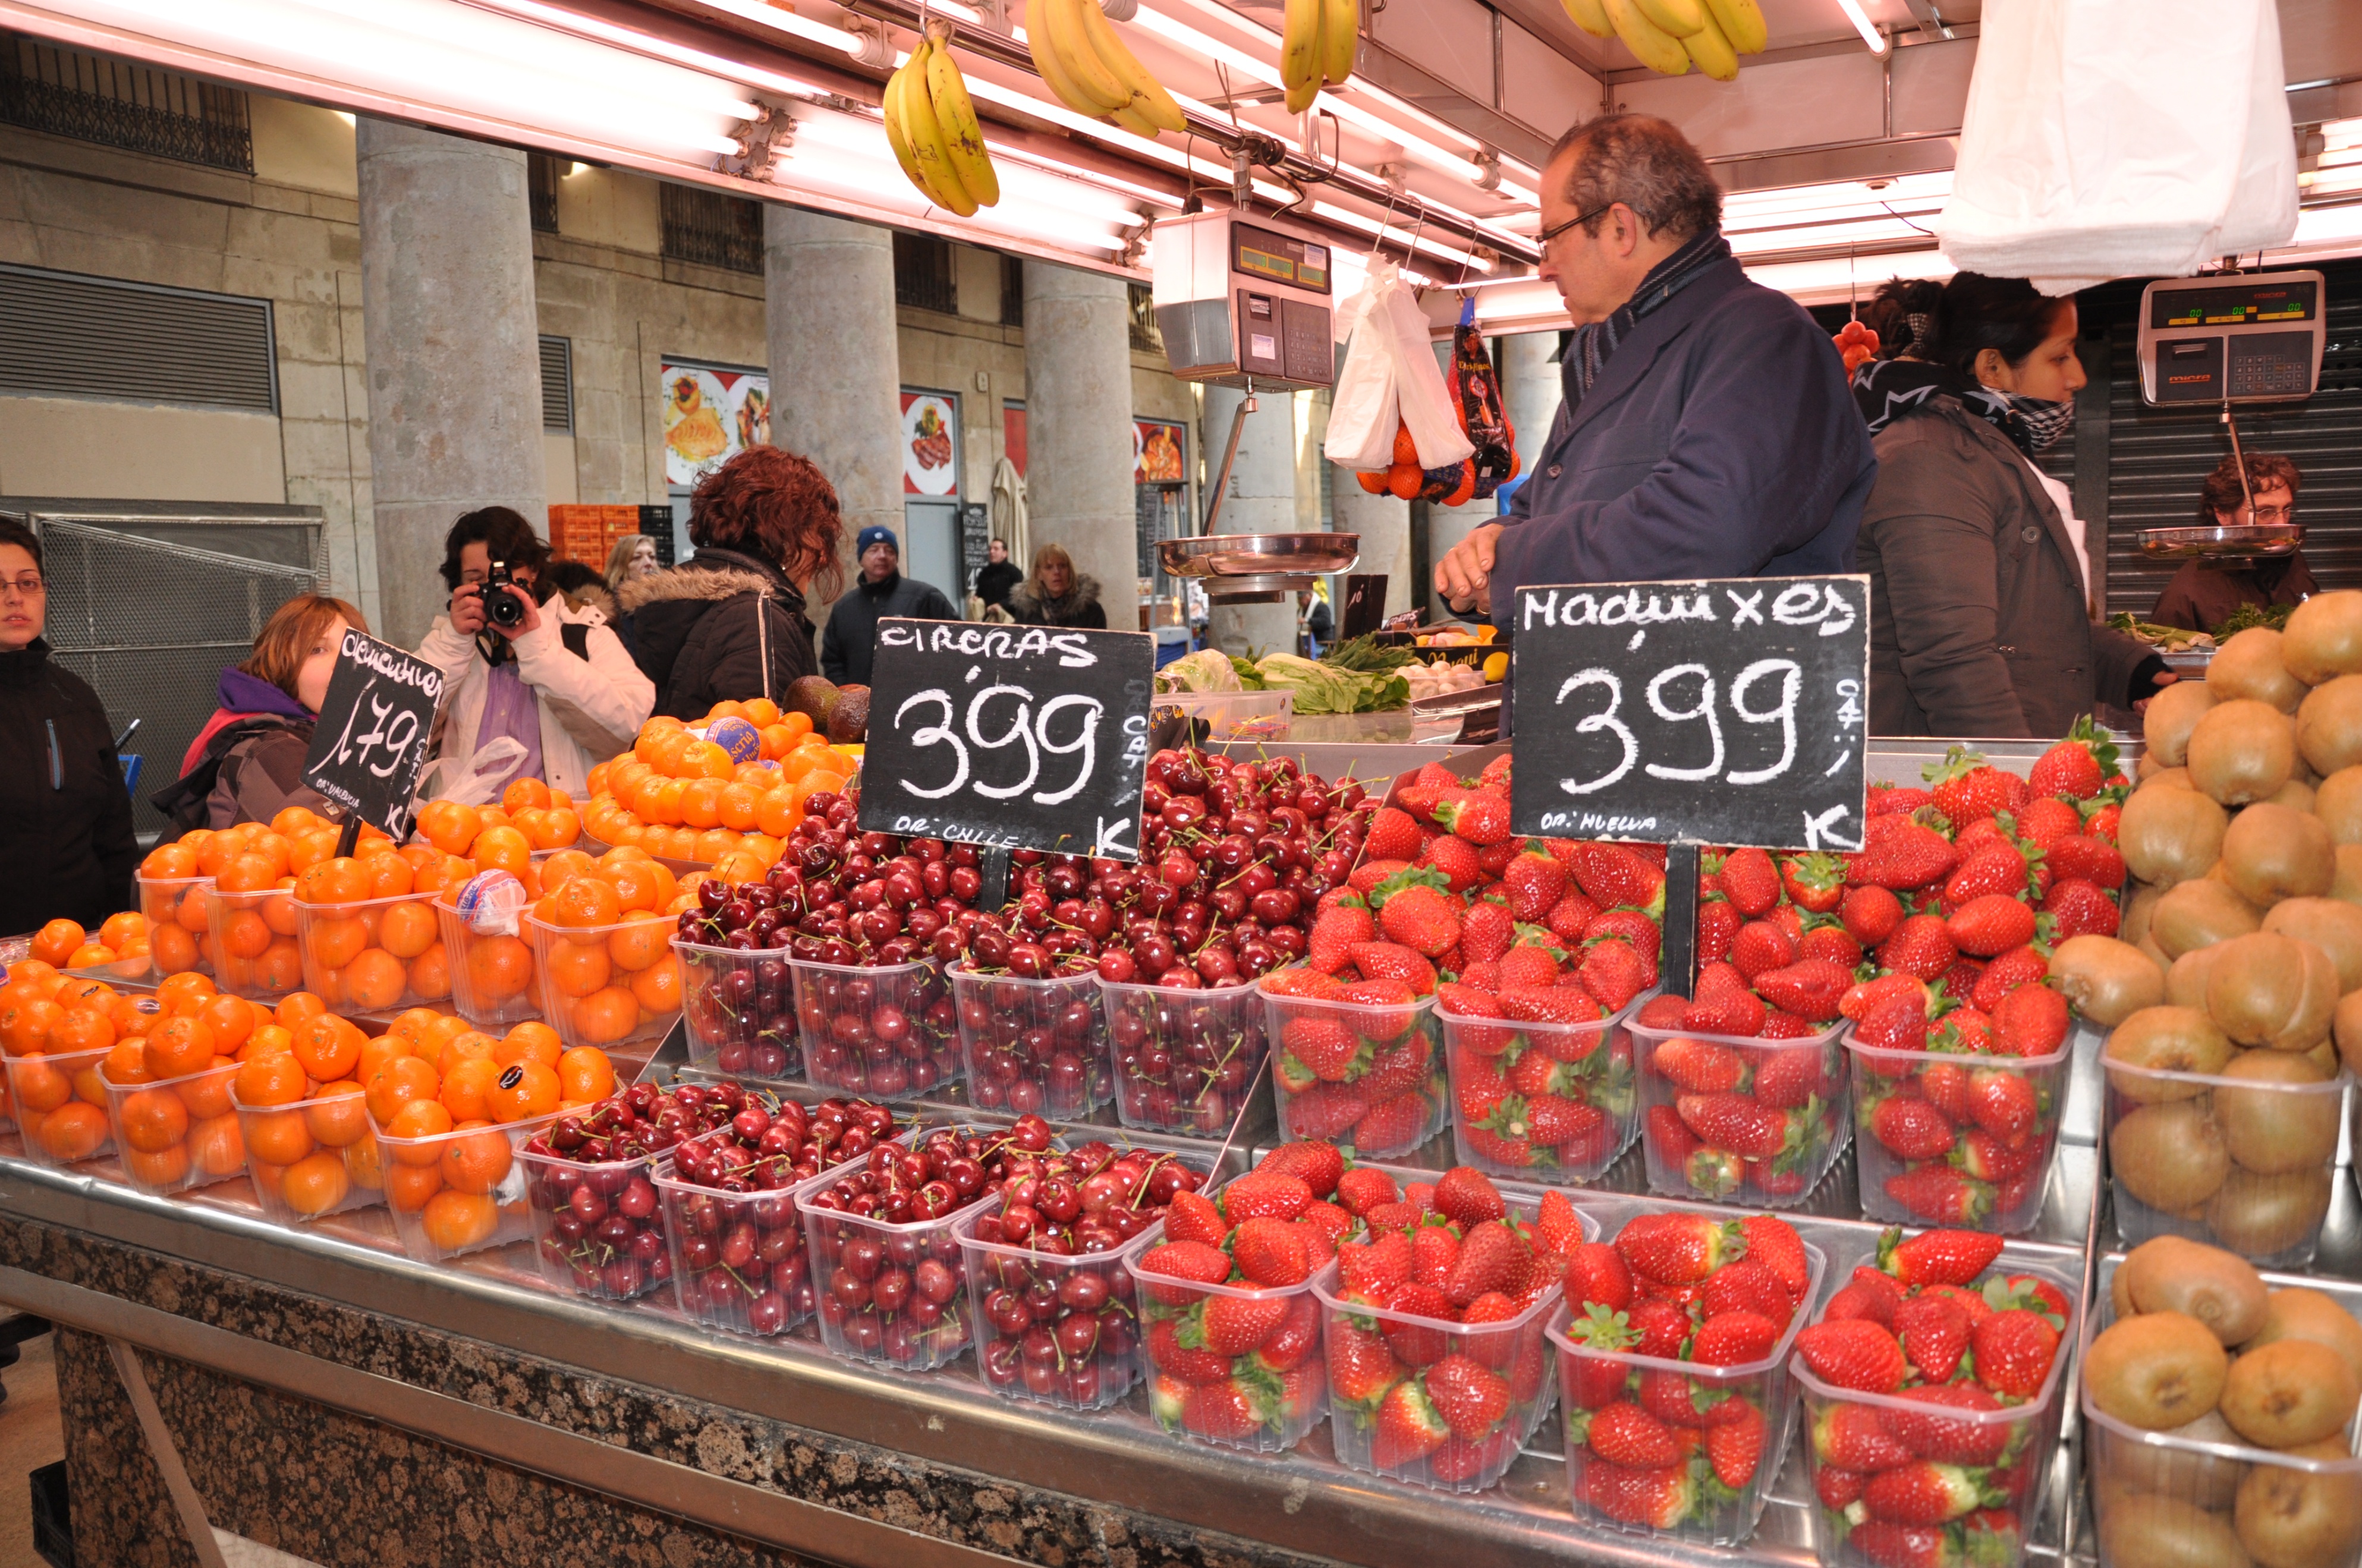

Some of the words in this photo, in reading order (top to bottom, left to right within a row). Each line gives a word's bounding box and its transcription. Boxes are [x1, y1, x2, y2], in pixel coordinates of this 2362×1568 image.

[385, 803, 404, 843] K
[1096, 816, 1138, 857] K
[1803, 804, 1863, 851] K
